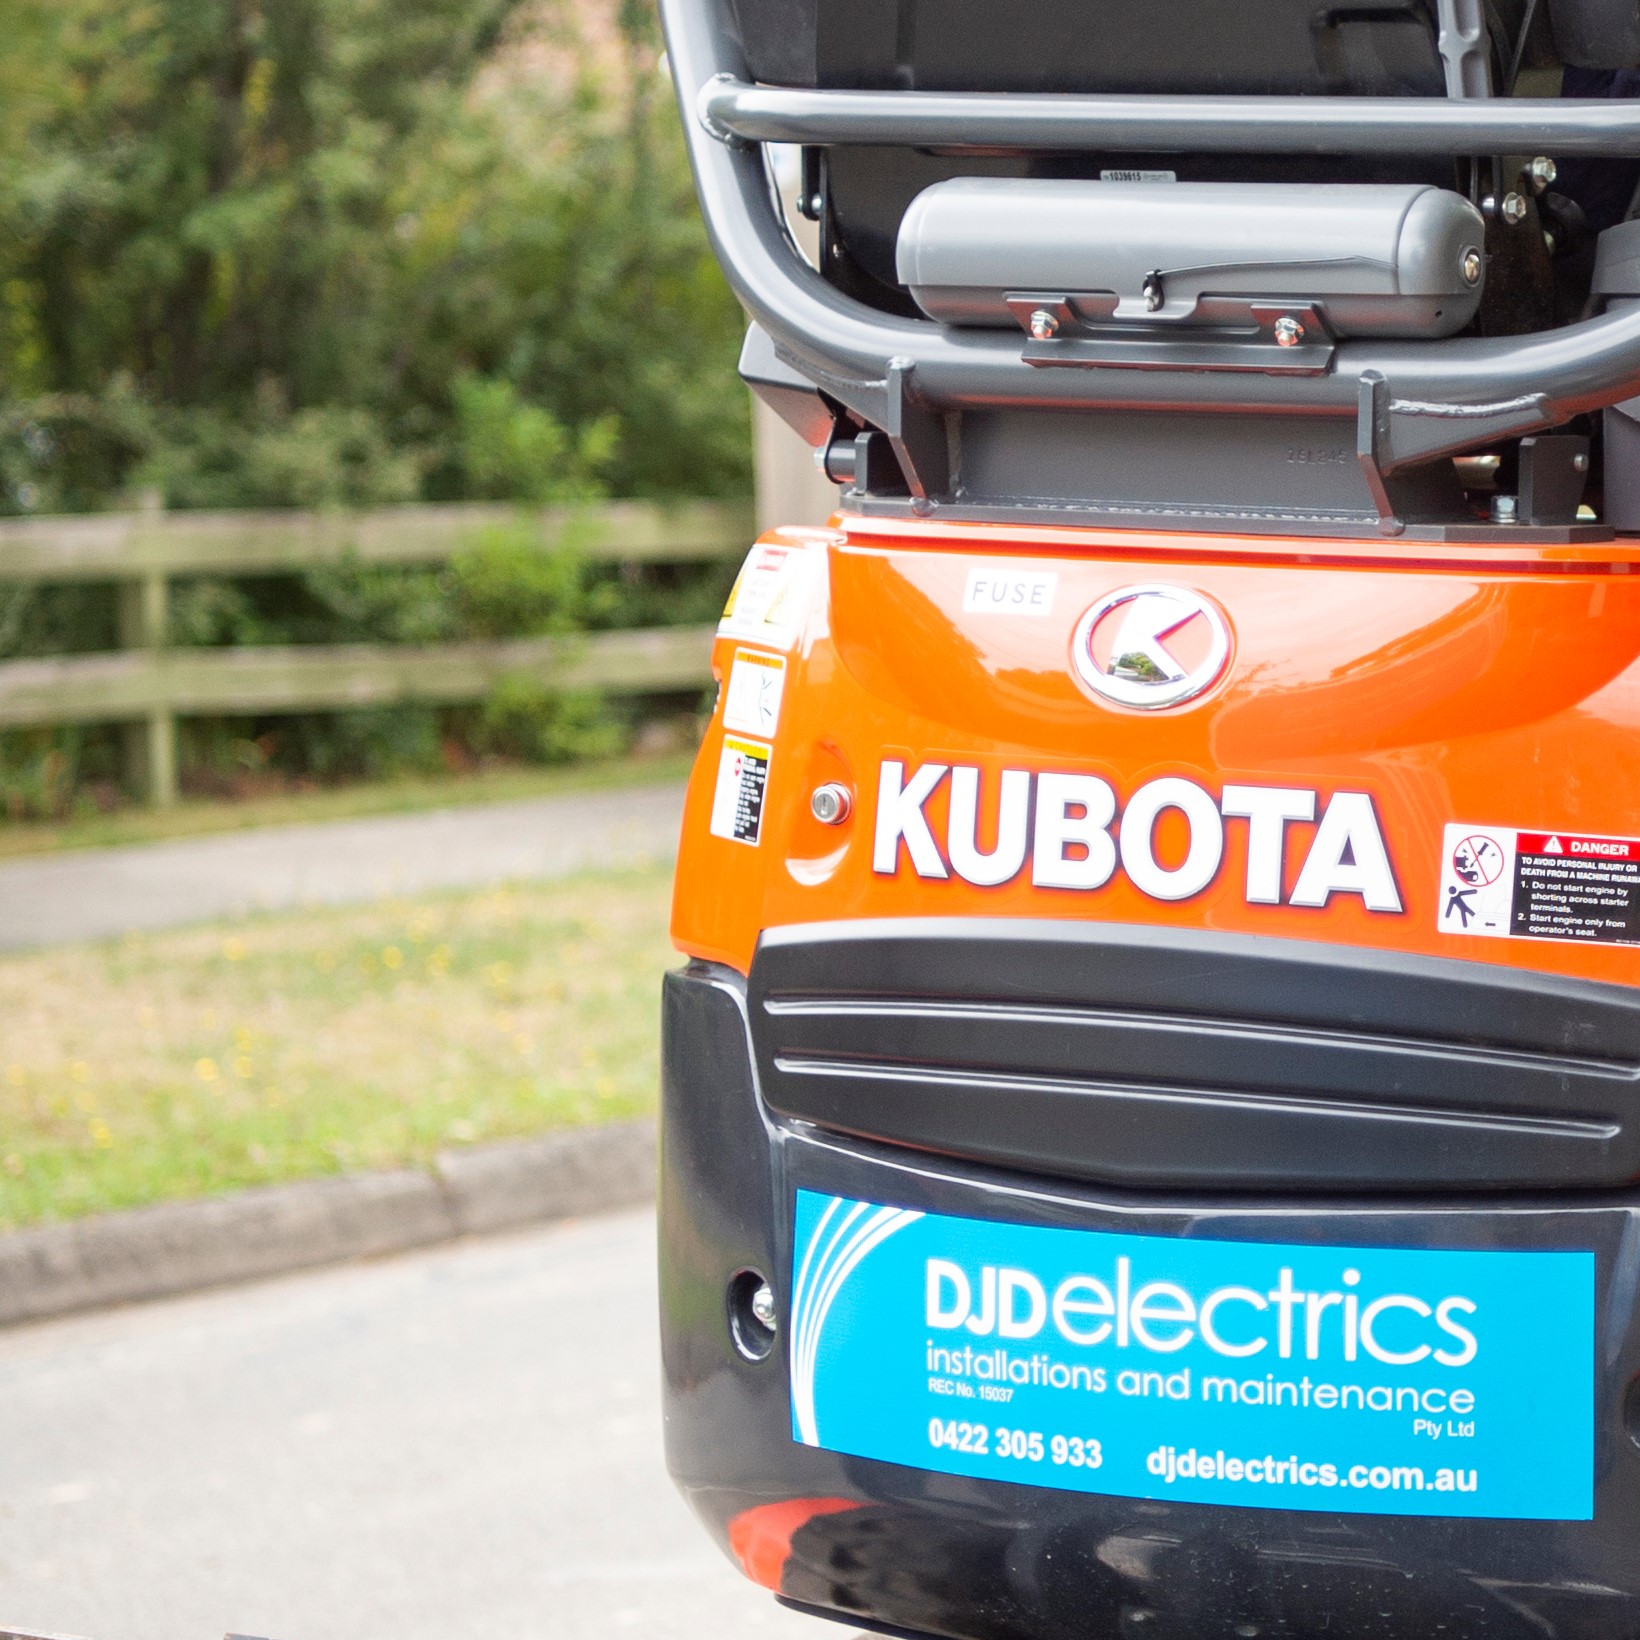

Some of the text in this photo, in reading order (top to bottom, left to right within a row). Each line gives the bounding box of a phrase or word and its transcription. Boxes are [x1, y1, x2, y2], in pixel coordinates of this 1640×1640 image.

[971, 580, 1046, 606] FUSE
[872, 760, 1404, 913] KUBOTA
[1570, 841, 1629, 856] DANGER
[1522, 857, 1637, 872] TO AVOID PERSONAL INJURY OR
[1521, 868, 1545, 877] DEATH
[1547, 870, 1568, 878] FROM
[1576, 872, 1609, 881] MACHINE
[1521, 881, 1529, 889] 1.
[1532, 882, 1545, 890] Do
[1563, 884, 1583, 892] start
[1585, 887, 1615, 896] engine
[1617, 888, 1629, 897] by
[1531, 893, 1629, 907] shorting across starter
[1530, 903, 1574, 914] terminals.
[1530, 914, 1552, 923] Start
[1553, 916, 1583, 926] engine
[1585, 918, 1604, 928] only
[1606, 920, 1626, 928] from
[1529, 926, 1597, 937] operator's seat.
[927, 1339, 1476, 1414] installations and maintenance
[928, 1378, 1014, 1403] REC No. 15037
[1413, 1418, 1475, 1440] Pty Ltd
[928, 1417, 1103, 1469] 0422 305 933
[1146, 1445, 1478, 1492] djdelectrics.com.au
